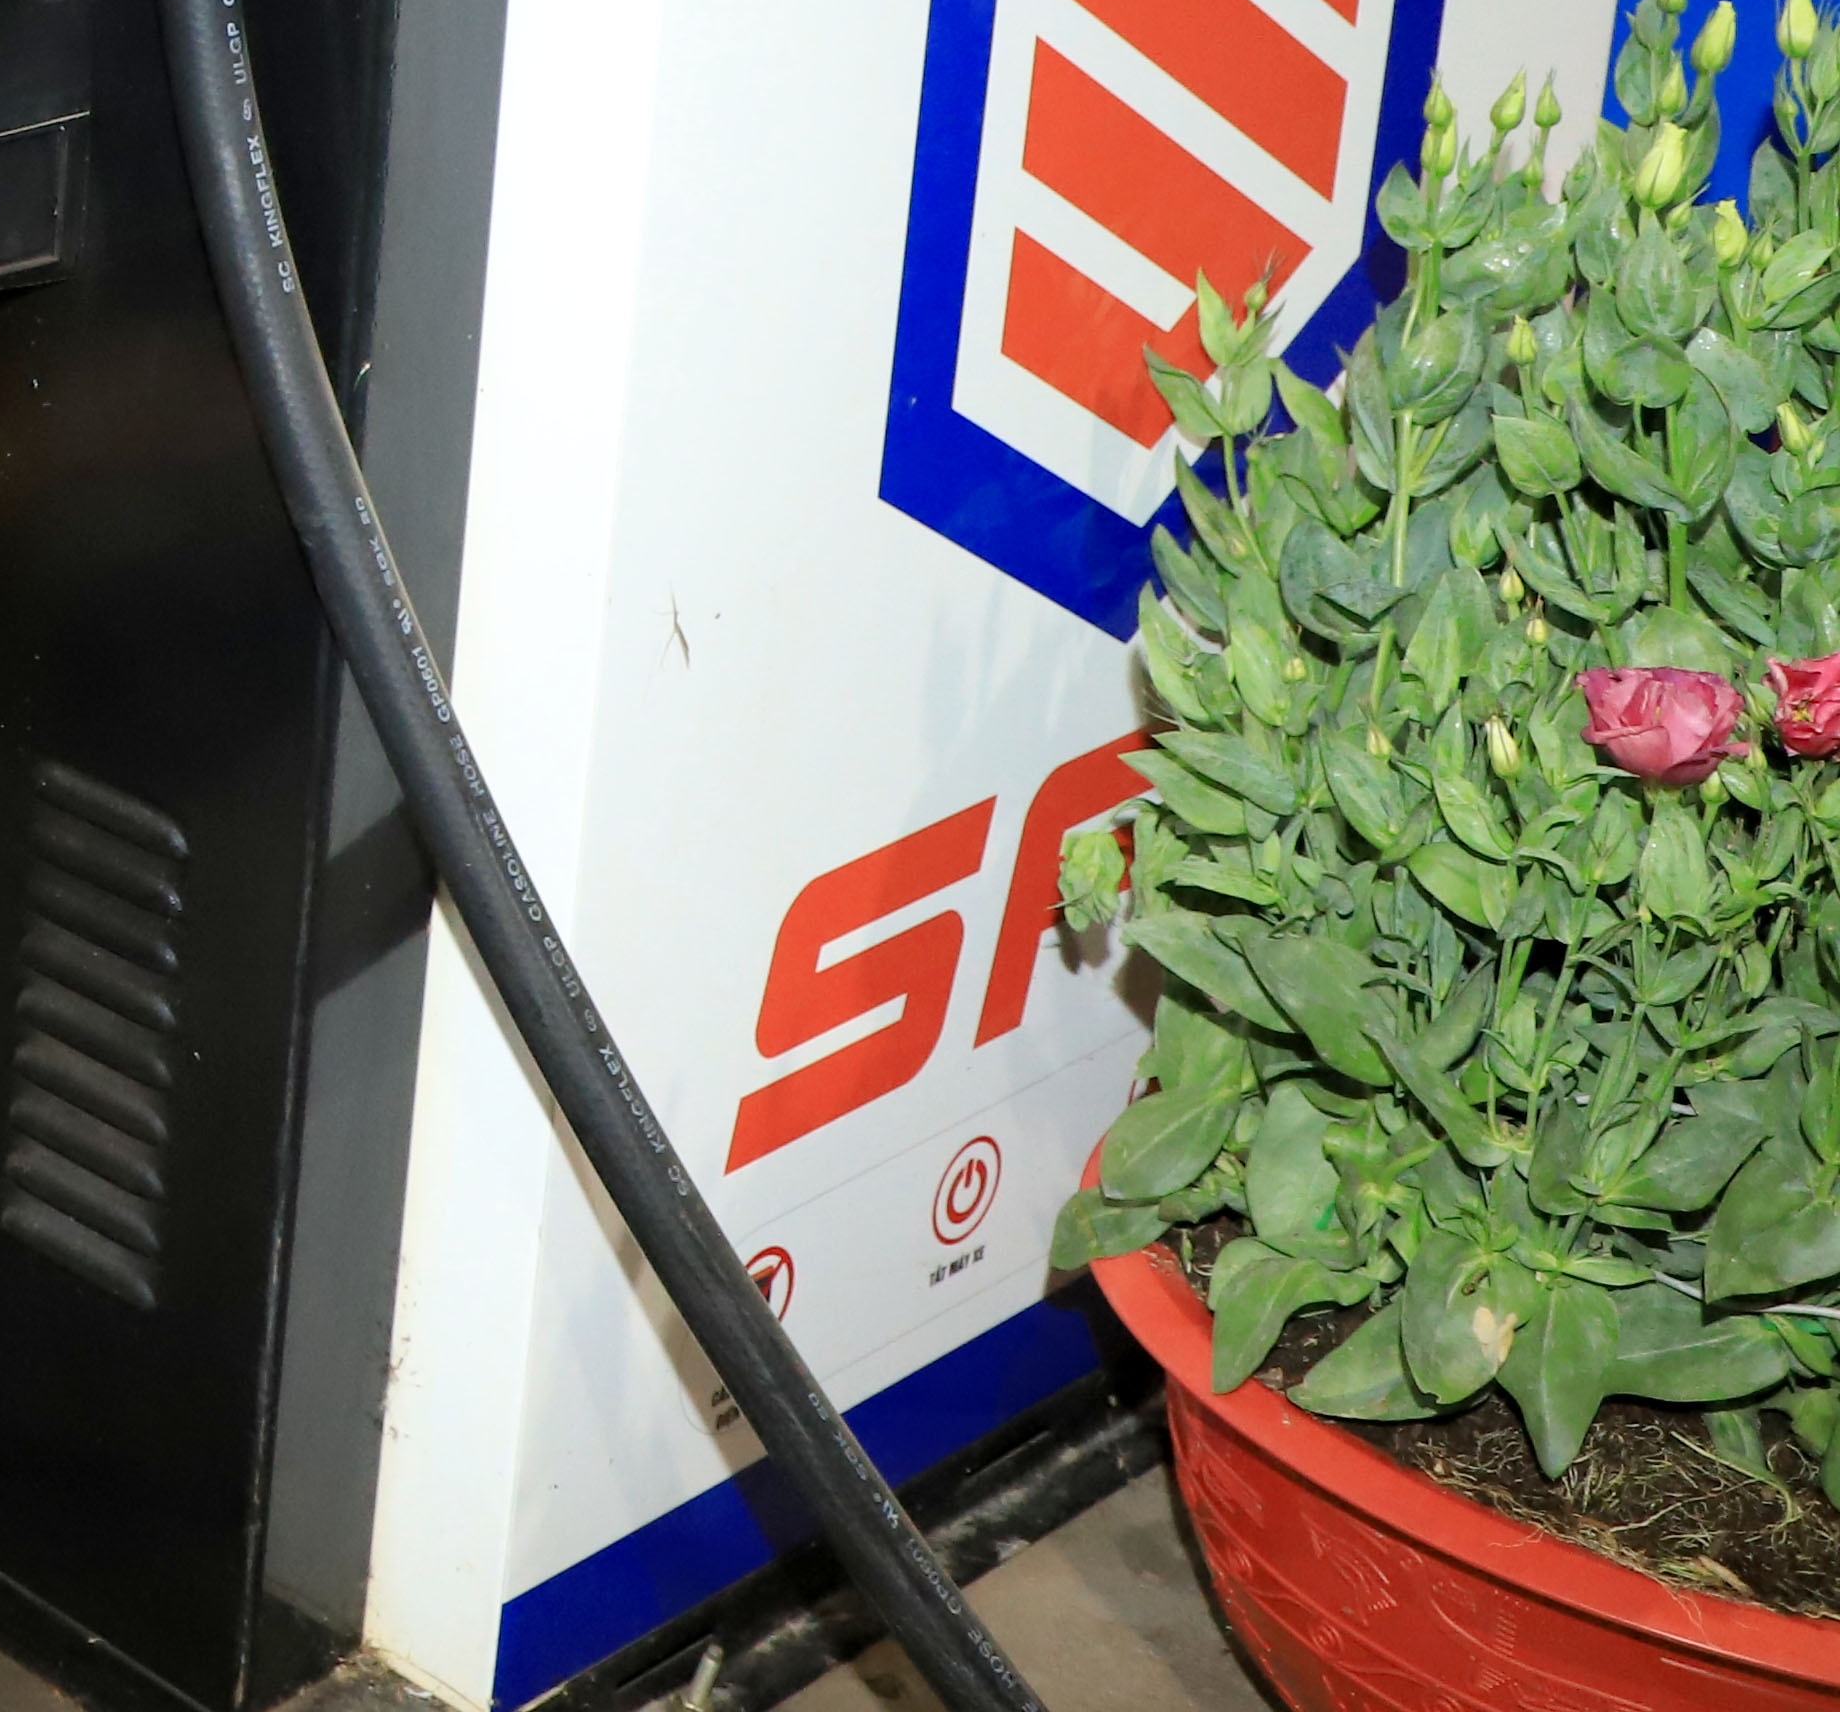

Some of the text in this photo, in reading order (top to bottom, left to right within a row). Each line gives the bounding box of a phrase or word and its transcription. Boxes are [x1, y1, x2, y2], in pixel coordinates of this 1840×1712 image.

[226, 22, 247, 85] ULGP
[246, 135, 284, 248] KINGFLEX
[278, 261, 295, 294] SC
[411, 646, 451, 724] GP0601
[449, 735, 486, 799] HOSE
[482, 808, 543, 923] GASOLINE
[543, 936, 580, 999] ULGP
[598, 1043, 666, 1155] KINGFLEX
[966, 1629, 1019, 1690] HOSE
